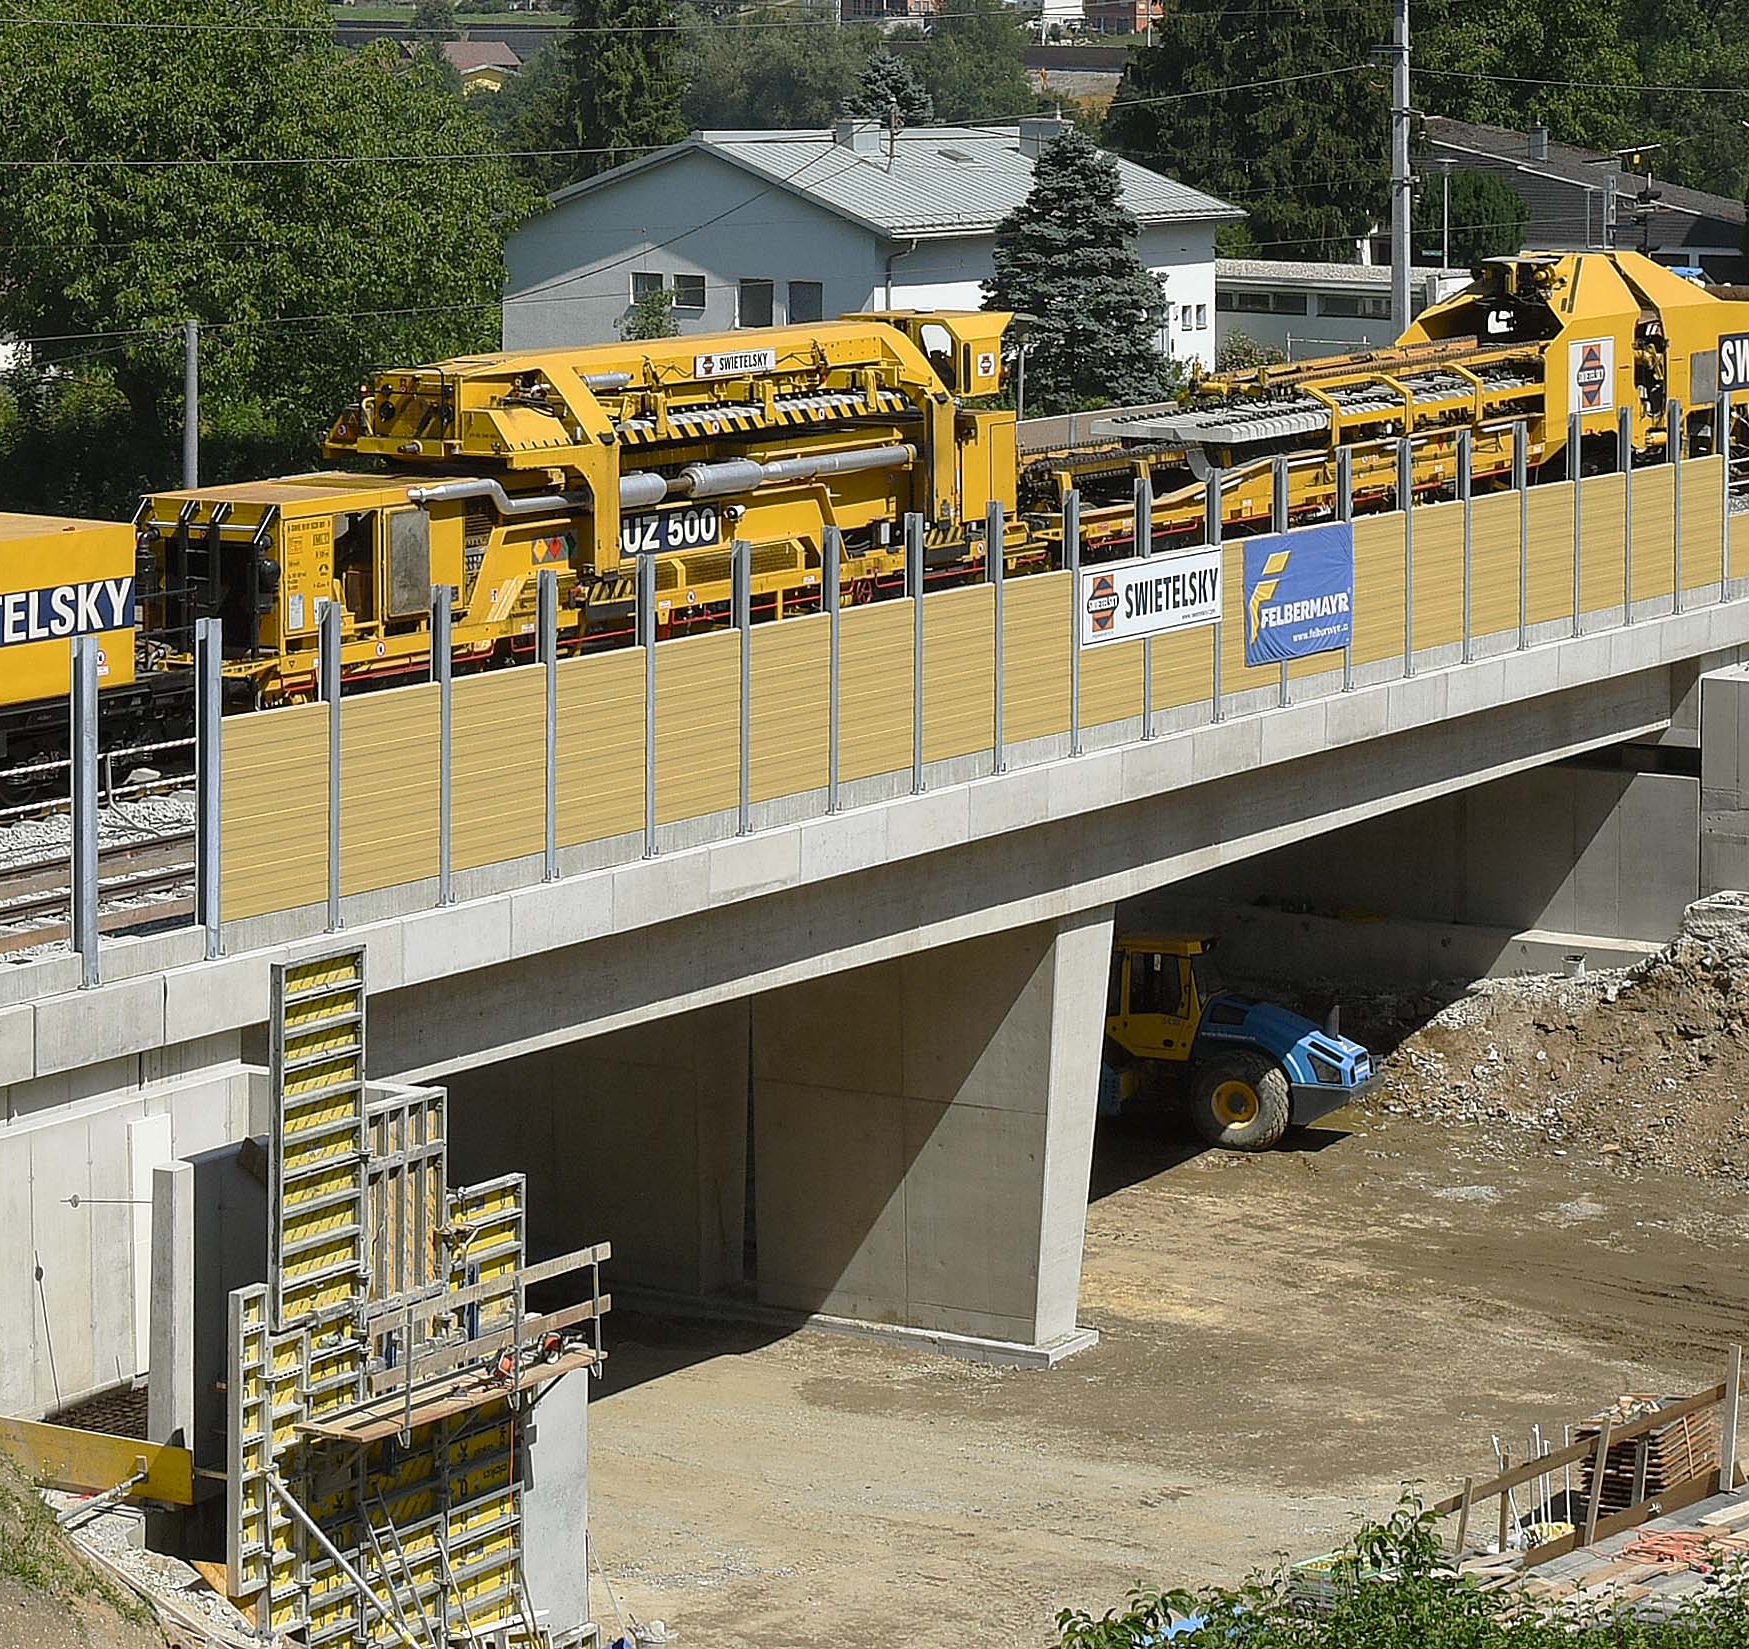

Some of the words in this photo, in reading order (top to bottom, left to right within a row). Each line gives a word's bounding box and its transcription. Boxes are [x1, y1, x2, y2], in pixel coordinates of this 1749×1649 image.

[719, 353, 768, 370] SWIETELSKY
[619, 515, 660, 553] UZ
[667, 508, 717, 546] 500
[1125, 568, 1219, 619] SWIETELSKY
[1261, 592, 1349, 628] FELBERMAYR
